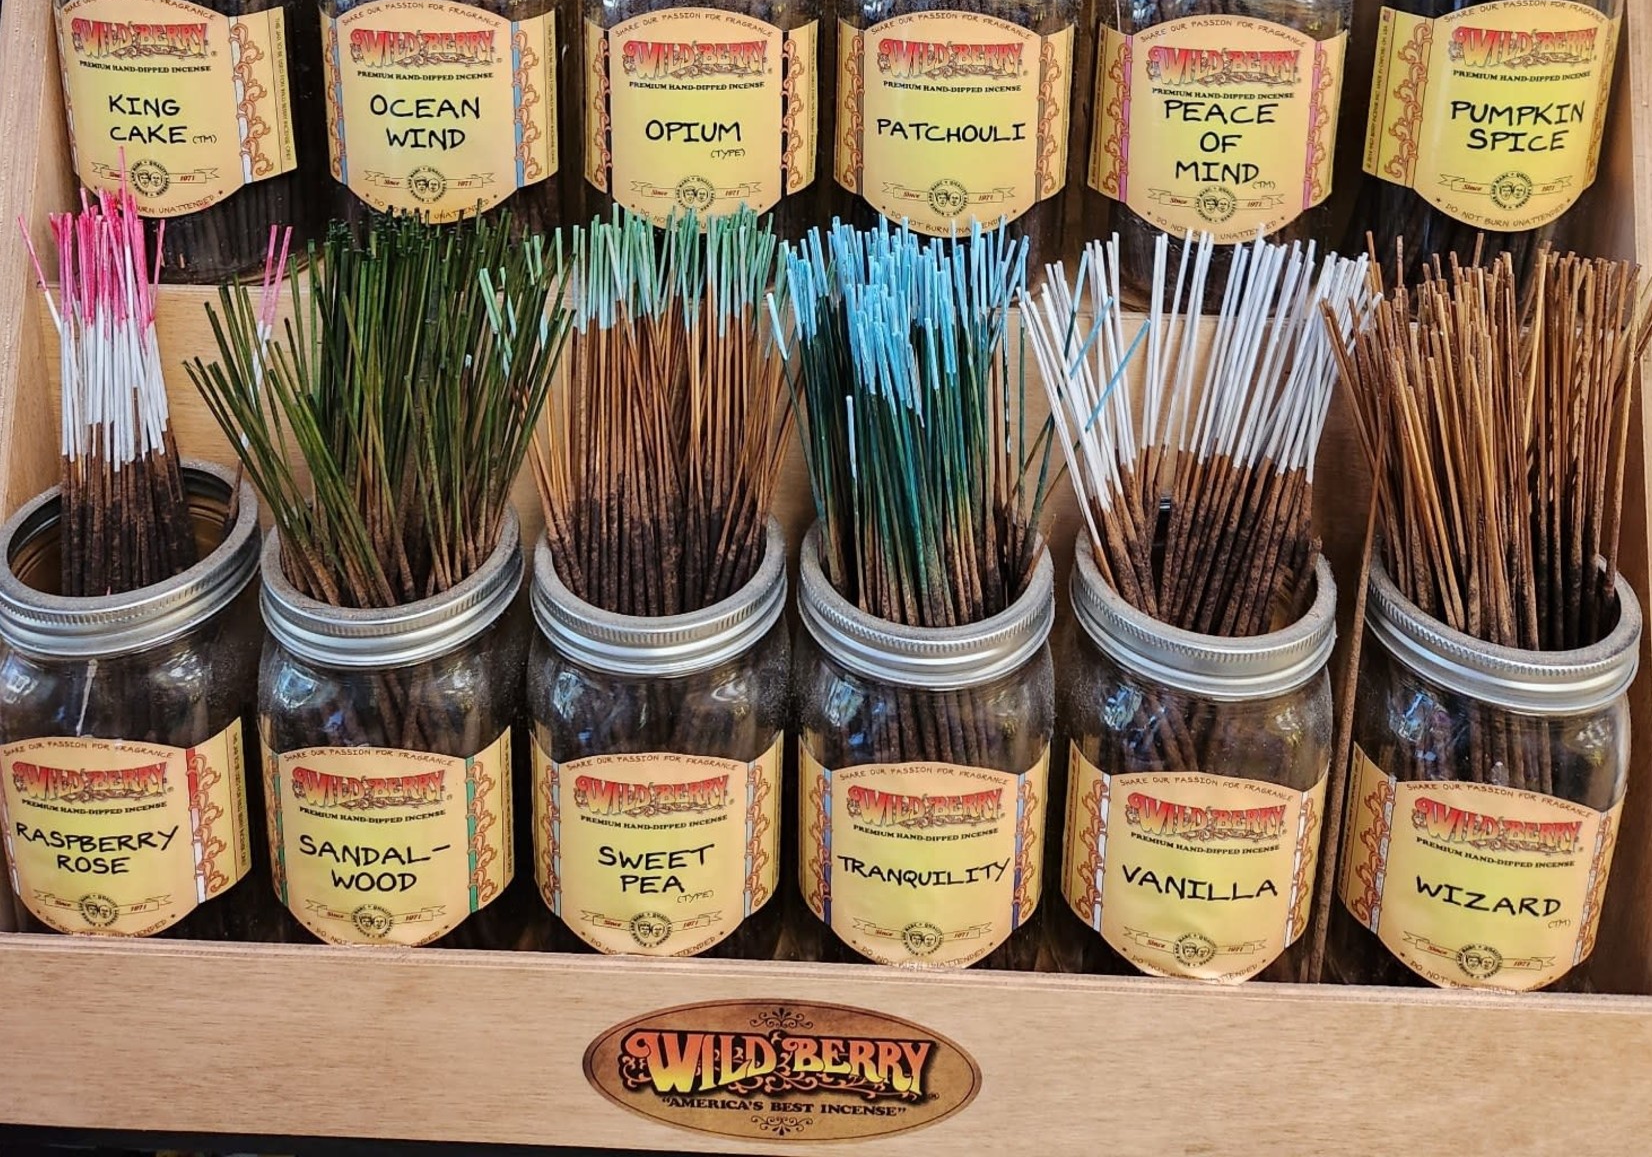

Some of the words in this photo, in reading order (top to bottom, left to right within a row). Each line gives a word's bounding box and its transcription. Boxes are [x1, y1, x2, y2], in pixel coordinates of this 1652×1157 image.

[342, 12, 364, 26] SHARE
[386, 2, 424, 10] PASSION
[449, 7, 501, 26] FRAGRANCE
[71, 17, 132, 58] WILD
[133, 22, 207, 58] BERRY
[351, 28, 421, 67] WILD
[423, 30, 495, 67] BERRY
[1449, 26, 1533, 68] WILD
[1536, 27, 1598, 66] BERRY
[79, 60, 111, 70] PREMIUM
[112, 65, 169, 73] HAND-DIPPED
[172, 65, 211, 73] INCENSE
[622, 40, 695, 79] WILD
[700, 40, 767, 77] BERRY
[877, 38, 950, 79] WILD
[953, 42, 1023, 79] BERRY
[1147, 46, 1224, 86] WILD
[1228, 49, 1300, 86] BERRY
[357, 70, 394, 79] PREMIUM
[396, 72, 454, 81] HAND-DIPPED
[456, 72, 493, 80] INCENSE
[629, 82, 666, 90] PREMIUM
[729, 82, 764, 90] INCENSE
[883, 81, 921, 91] PREMIUM
[923, 85, 982, 93] HAND-DIPPED
[1453, 70, 1498, 80] PREMIUM
[1562, 71, 1591, 80] INCENSE
[108, 94, 180, 117] KING
[1152, 87, 1192, 98] PREMIUM
[1194, 92, 1256, 100] HAND-DIPPED
[370, 94, 480, 119] OCEAN
[1164, 100, 1278, 124] PEACE
[1451, 100, 1585, 126] PUMPKIN
[110, 124, 187, 144] CAKE
[386, 128, 465, 151] WIND
[646, 120, 741, 142] OPIUM
[877, 119, 1026, 142] PATCHOULI
[1200, 132, 1242, 153] OF
[1467, 128, 1569, 152] SPICE
[1175, 161, 1259, 185] MIND
[284, 752, 307, 763] SHARE
[311, 749, 326, 757] OUR
[399, 752, 455, 766] FRAGRANCE
[13, 761, 84, 800] WILD
[86, 761, 168, 799] BERRY
[292, 766, 363, 807] WILD
[368, 769, 445, 808] BERRY
[22, 799, 58, 812] PREMIUM
[60, 806, 123, 815] HAND-DIPPED
[125, 801, 167, 813] INCENSE
[574, 775, 650, 816] WILD
[654, 775, 729, 815] BERRY
[847, 785, 924, 827] WILD
[928, 788, 1003, 827] BERRY
[300, 806, 338, 820] PREMIUM
[340, 814, 403, 824] HAND-DIPPED
[405, 809, 446, 822] INCENSE
[580, 815, 621, 828] PREMIUM
[623, 822, 686, 830] HAND-DIPPED
[689, 814, 728, 827] INCENSE
[1125, 792, 1209, 836] WILD
[1212, 804, 1286, 842] BERRY
[1412, 797, 1500, 846] WILD
[1503, 819, 1582, 855] BERRY
[16, 822, 179, 853] RASPBERRY
[853, 825, 894, 838] PREMIUM
[896, 833, 959, 841] HAND-DIPPED
[961, 828, 999, 840] INCENSE
[1131, 832, 1174, 848] PREMIUM
[1176, 844, 1240, 854] HAND-DIPPED
[1242, 844, 1279, 854] INCENSE
[598, 844, 714, 870] SWEET
[1417, 836, 1462, 857] PREMIUM
[1465, 853, 1533, 868] HAND-DIPPED
[1535, 860, 1574, 868] INCENSE
[57, 855, 130, 874] ROSE
[837, 855, 1010, 889] TRANQUILITY
[332, 869, 417, 891] WOOD
[620, 875, 685, 894] PEA
[1122, 864, 1278, 901] VANILLA
[1416, 876, 1561, 917] WIZARD
[620, 1029, 777, 1093] WILD
[782, 1036, 935, 1099] BERRY
[770, 1102, 814, 1114] BEST
